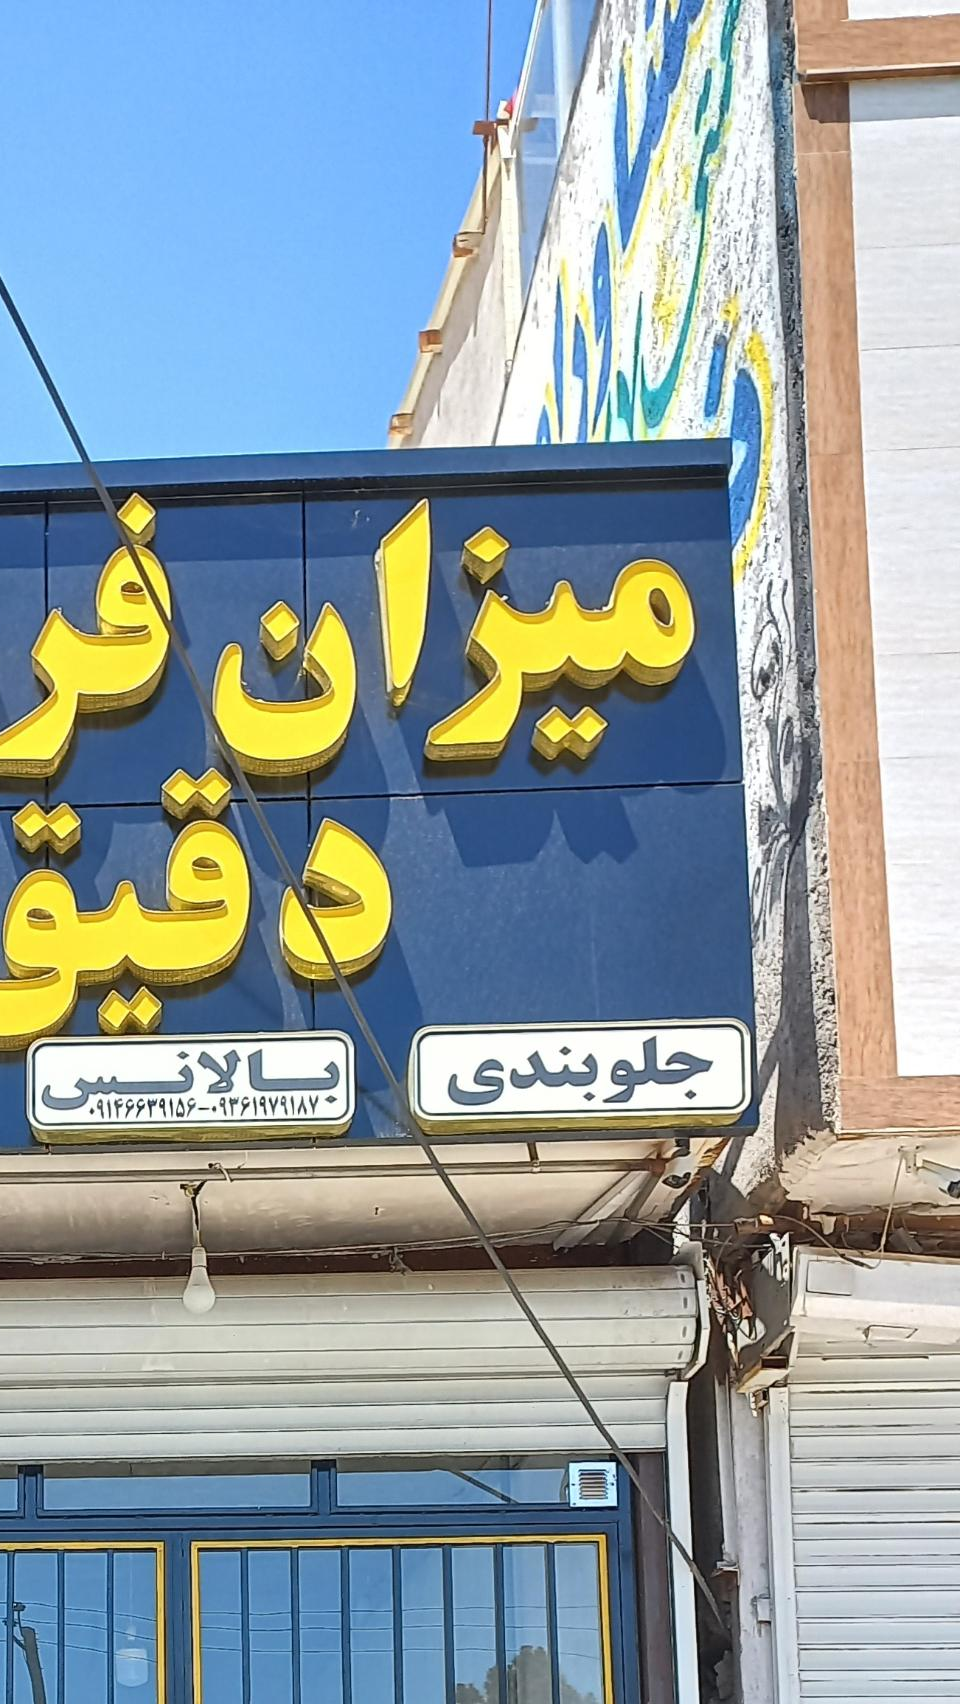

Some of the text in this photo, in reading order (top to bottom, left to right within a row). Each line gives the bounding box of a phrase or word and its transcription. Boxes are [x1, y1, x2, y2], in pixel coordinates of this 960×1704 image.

[214, 499, 697, 775] میزان
[41, 1049, 340, 1111] بالانس
[447, 1036, 714, 1106] جلوبندی
